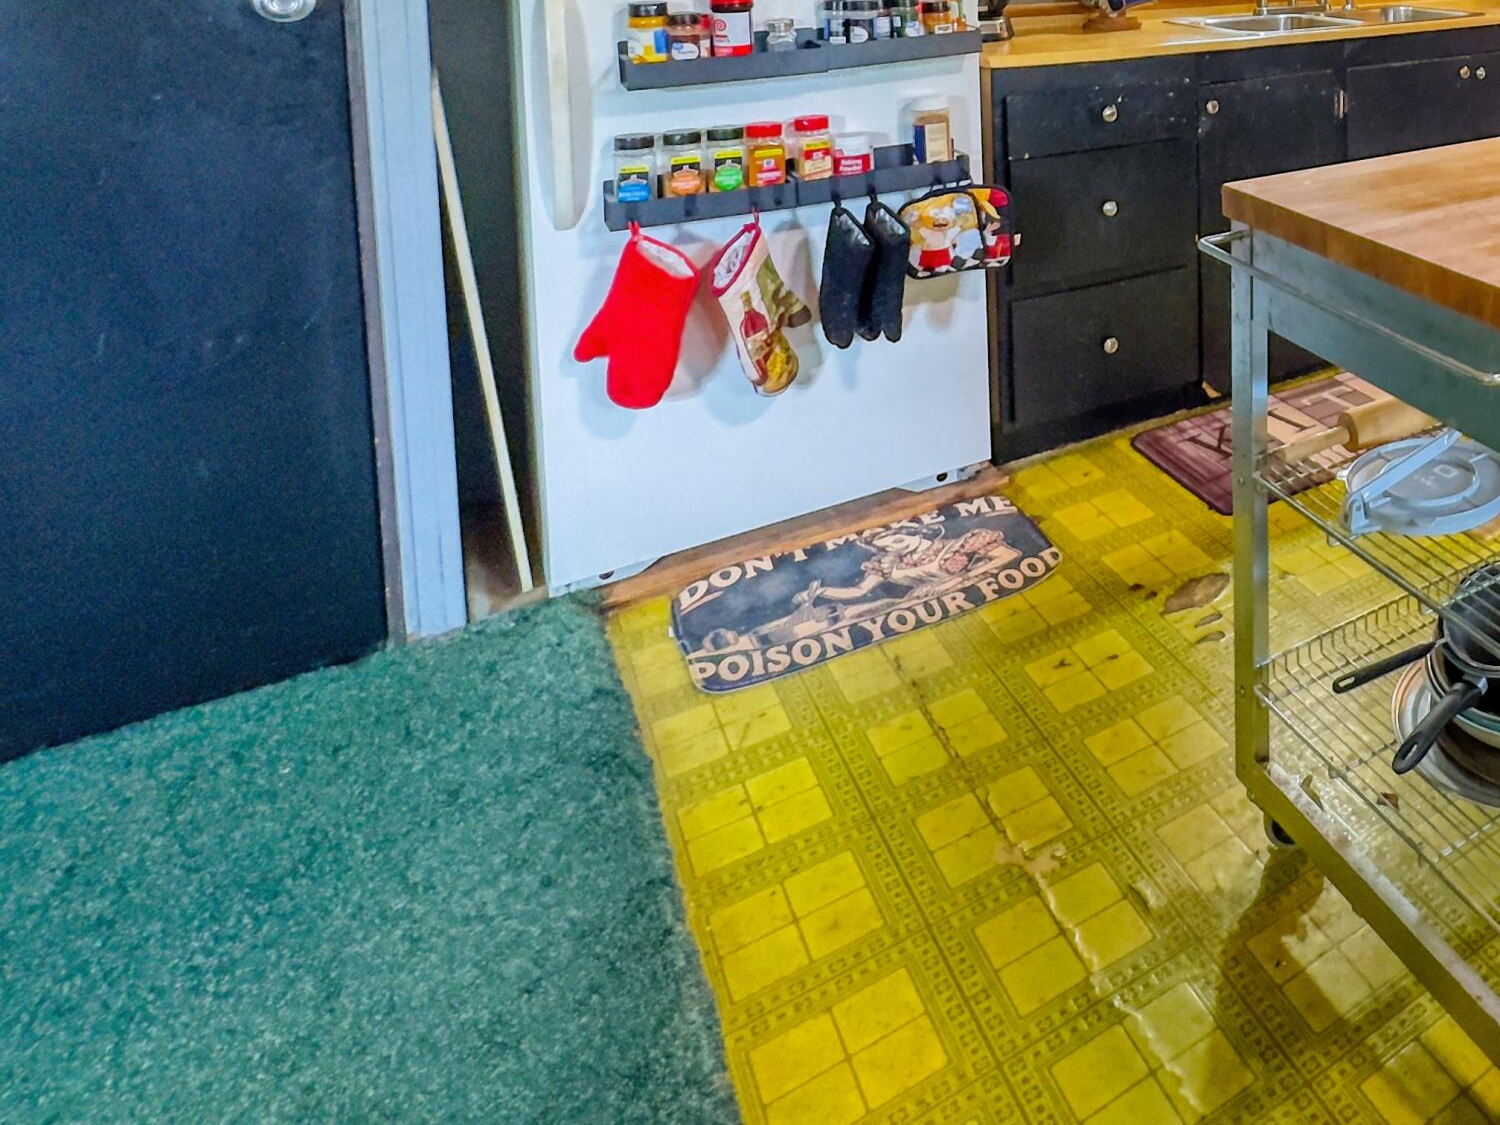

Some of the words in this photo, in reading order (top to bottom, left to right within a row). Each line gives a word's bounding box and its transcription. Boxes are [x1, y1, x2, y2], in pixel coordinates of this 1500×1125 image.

[953, 496, 1017, 517] ME
[688, 627, 855, 687] POISON
[858, 592, 975, 641] YOUR
[974, 546, 1063, 601] FOOD
